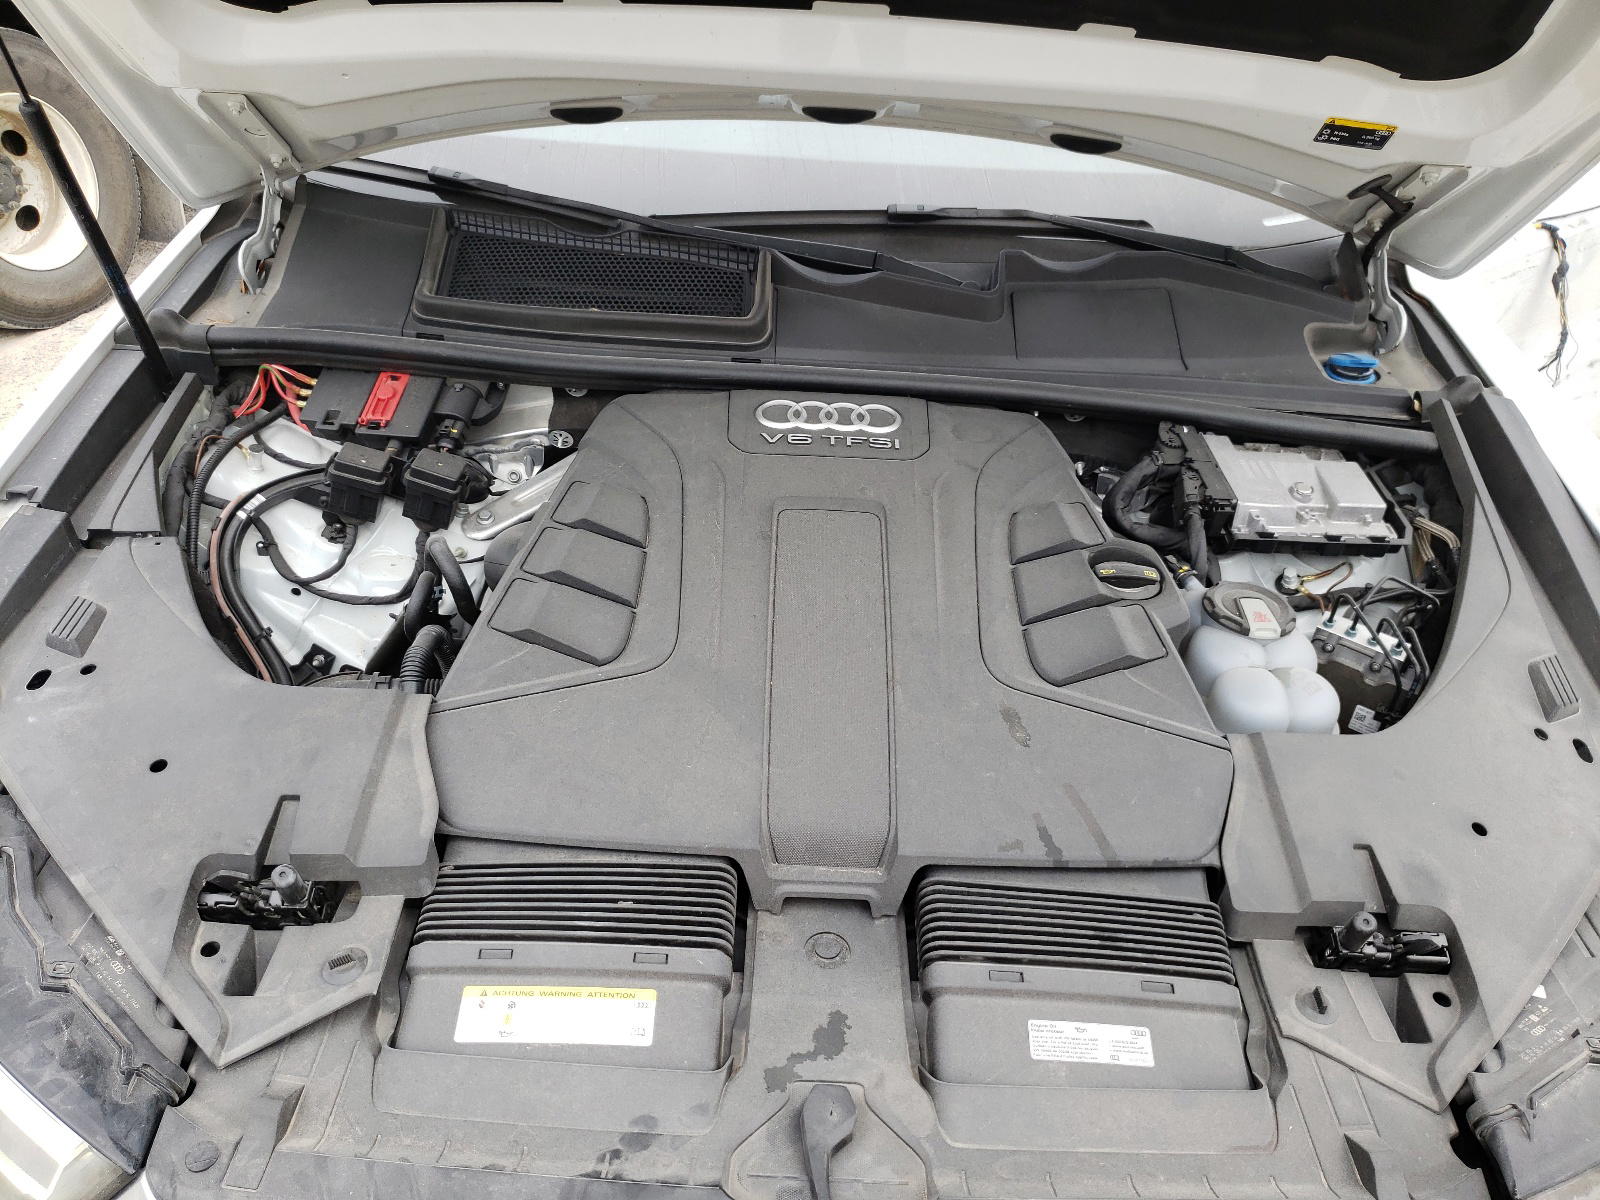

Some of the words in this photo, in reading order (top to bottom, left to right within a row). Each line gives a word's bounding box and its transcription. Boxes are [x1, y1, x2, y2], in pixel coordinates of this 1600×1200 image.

[760, 432, 813, 445] V6
[821, 434, 900, 450] TFSI
[492, 989, 535, 997] ACHTUNG
[539, 990, 583, 998] WARNING
[587, 991, 636, 999] ATTENTION
